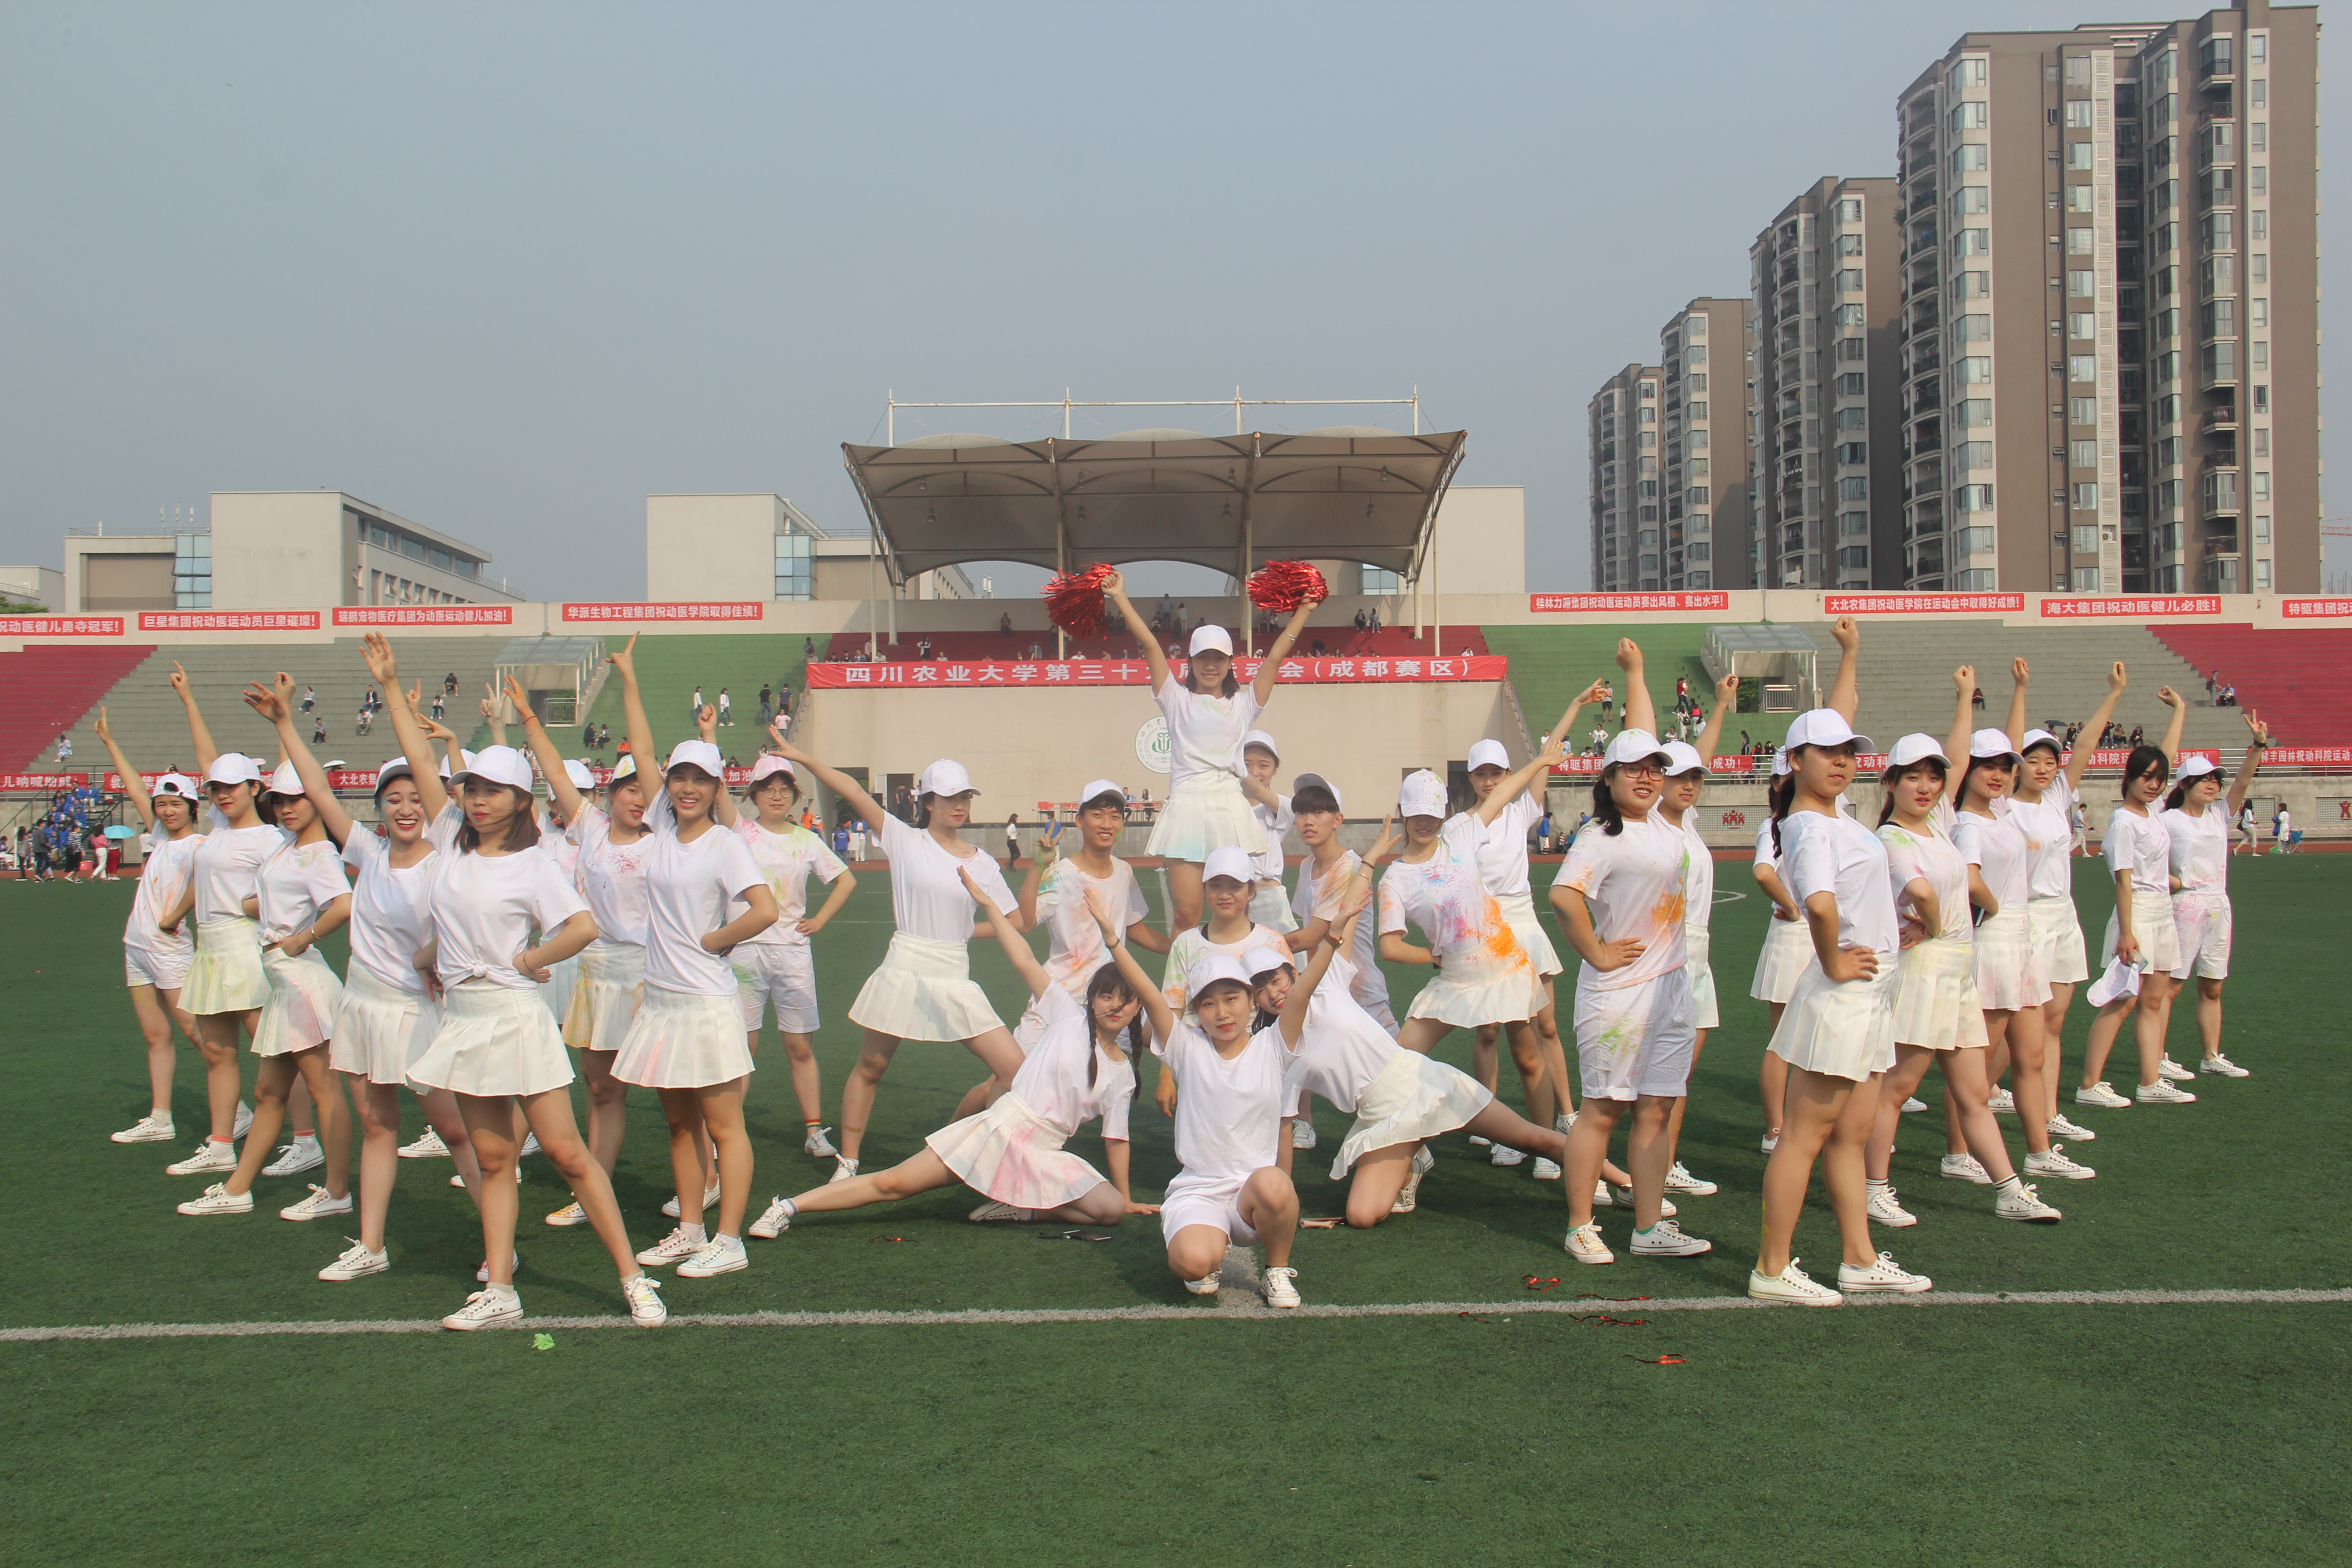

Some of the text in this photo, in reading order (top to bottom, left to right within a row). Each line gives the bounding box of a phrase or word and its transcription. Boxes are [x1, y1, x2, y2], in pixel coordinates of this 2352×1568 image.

[2047, 599, 2216, 614] 海大集团祝动医健儿必胜!
[144, 615, 315, 627] 巨星集团祝动医运动员巨星璀璨!
[1709, 756, 1740, 769] 成功!
